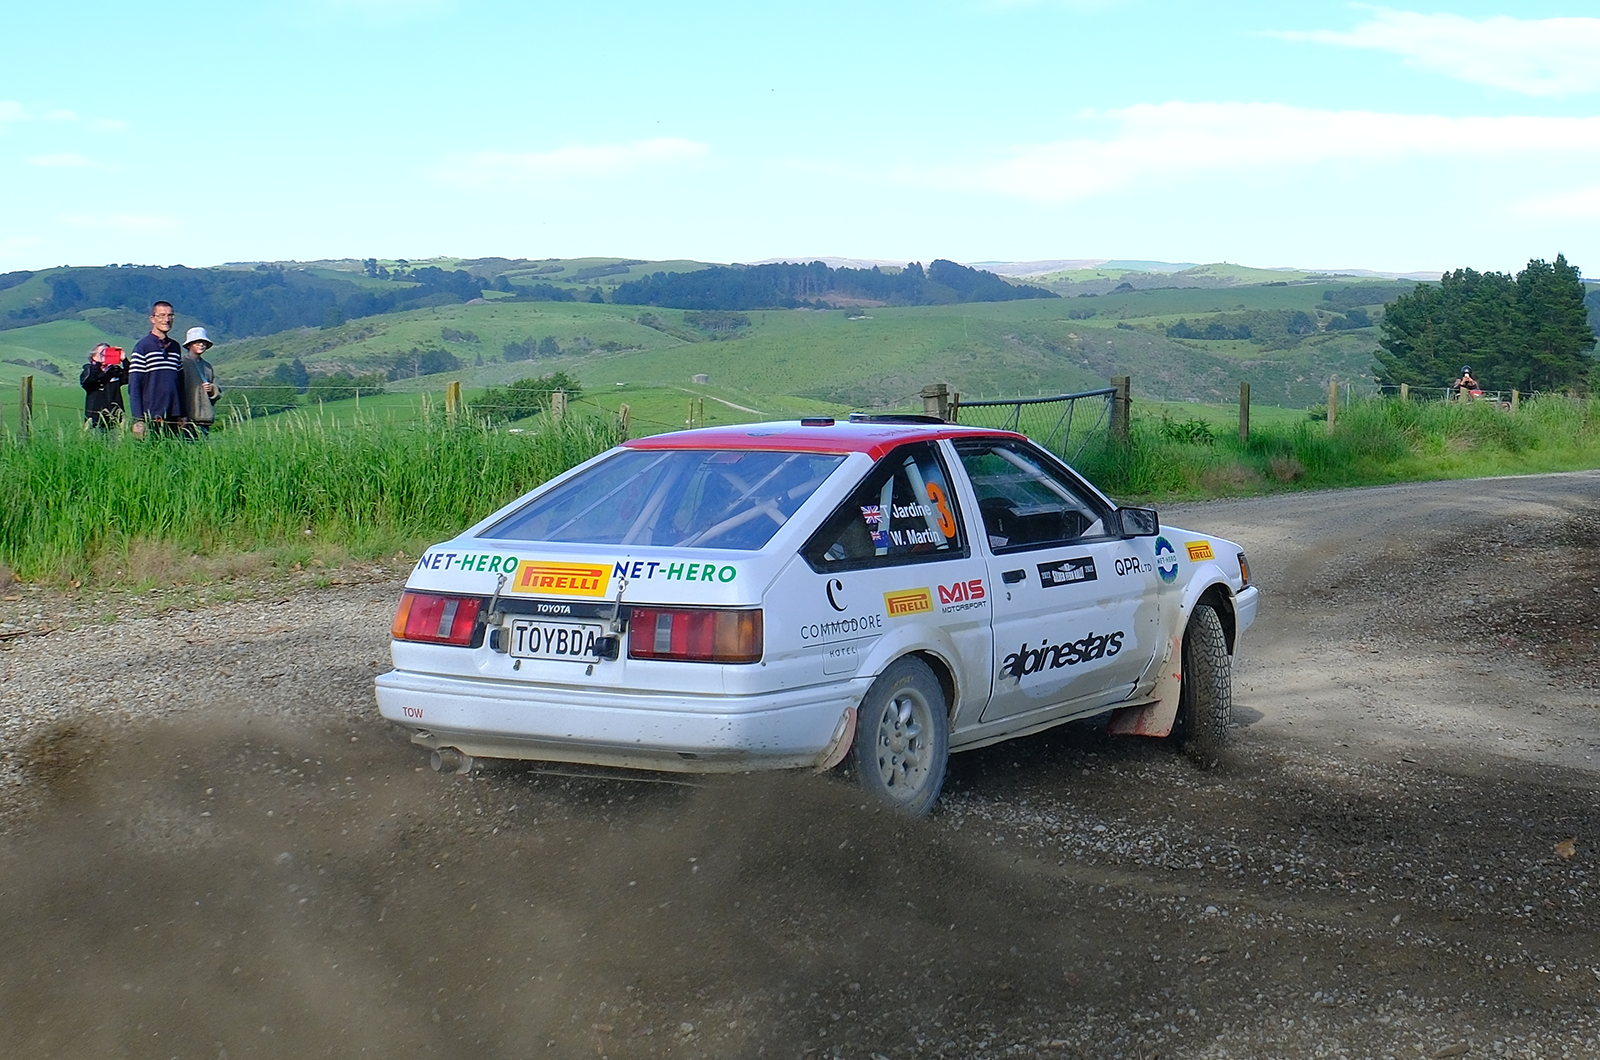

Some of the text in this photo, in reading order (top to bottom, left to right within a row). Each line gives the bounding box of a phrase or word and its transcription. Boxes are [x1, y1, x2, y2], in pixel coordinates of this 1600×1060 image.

[892, 502, 932, 519] Jardine
[925, 482, 955, 538] 3
[890, 528, 941, 546] W. Martin
[1188, 545, 1212, 560] PIRELLI
[417, 553, 519, 574] NET-HERO
[612, 560, 737, 583] NET-HERO
[520, 566, 603, 590] PIRELLI
[825, 578, 849, 612] C
[937, 579, 986, 605] MIS
[537, 604, 571, 614] TOYOTA
[887, 593, 930, 614] PIRELLI
[941, 601, 987, 614] MOTORSPORT
[800, 614, 882, 640] COMMODORE
[516, 626, 596, 657] TOYBDA
[829, 646, 858, 658] HOTEL
[998, 631, 1125, 686] alpinestars
[402, 706, 424, 719] TOW
